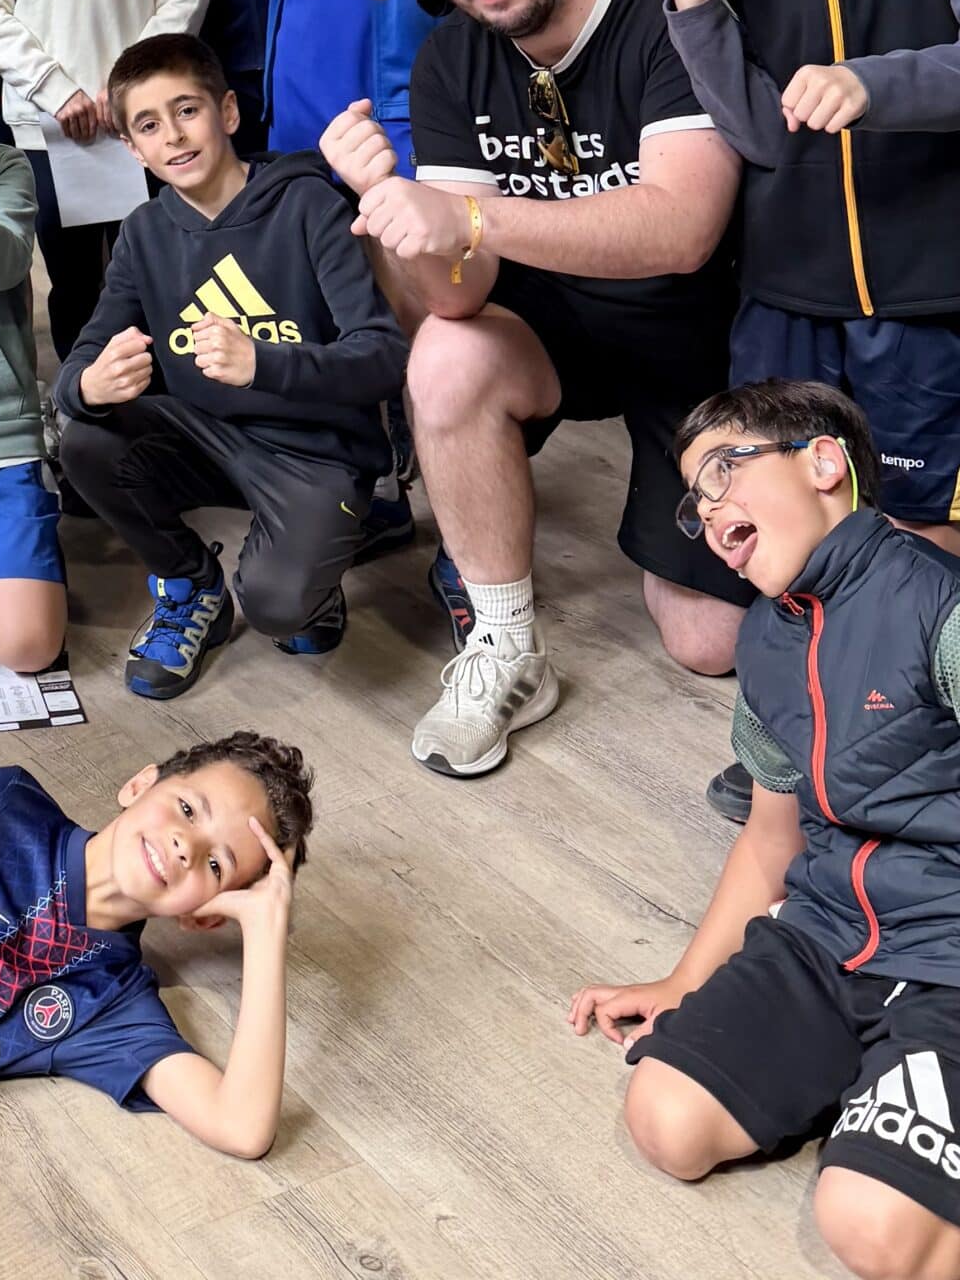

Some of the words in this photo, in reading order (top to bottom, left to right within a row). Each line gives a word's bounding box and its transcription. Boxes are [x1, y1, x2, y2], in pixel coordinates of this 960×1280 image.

[478, 127, 605, 167] barjts
[169, 315, 302, 356] aas
[880, 453, 924, 471] tempo
[50, 988, 70, 1020] PARIS
[830, 1099, 960, 1180] adidas
